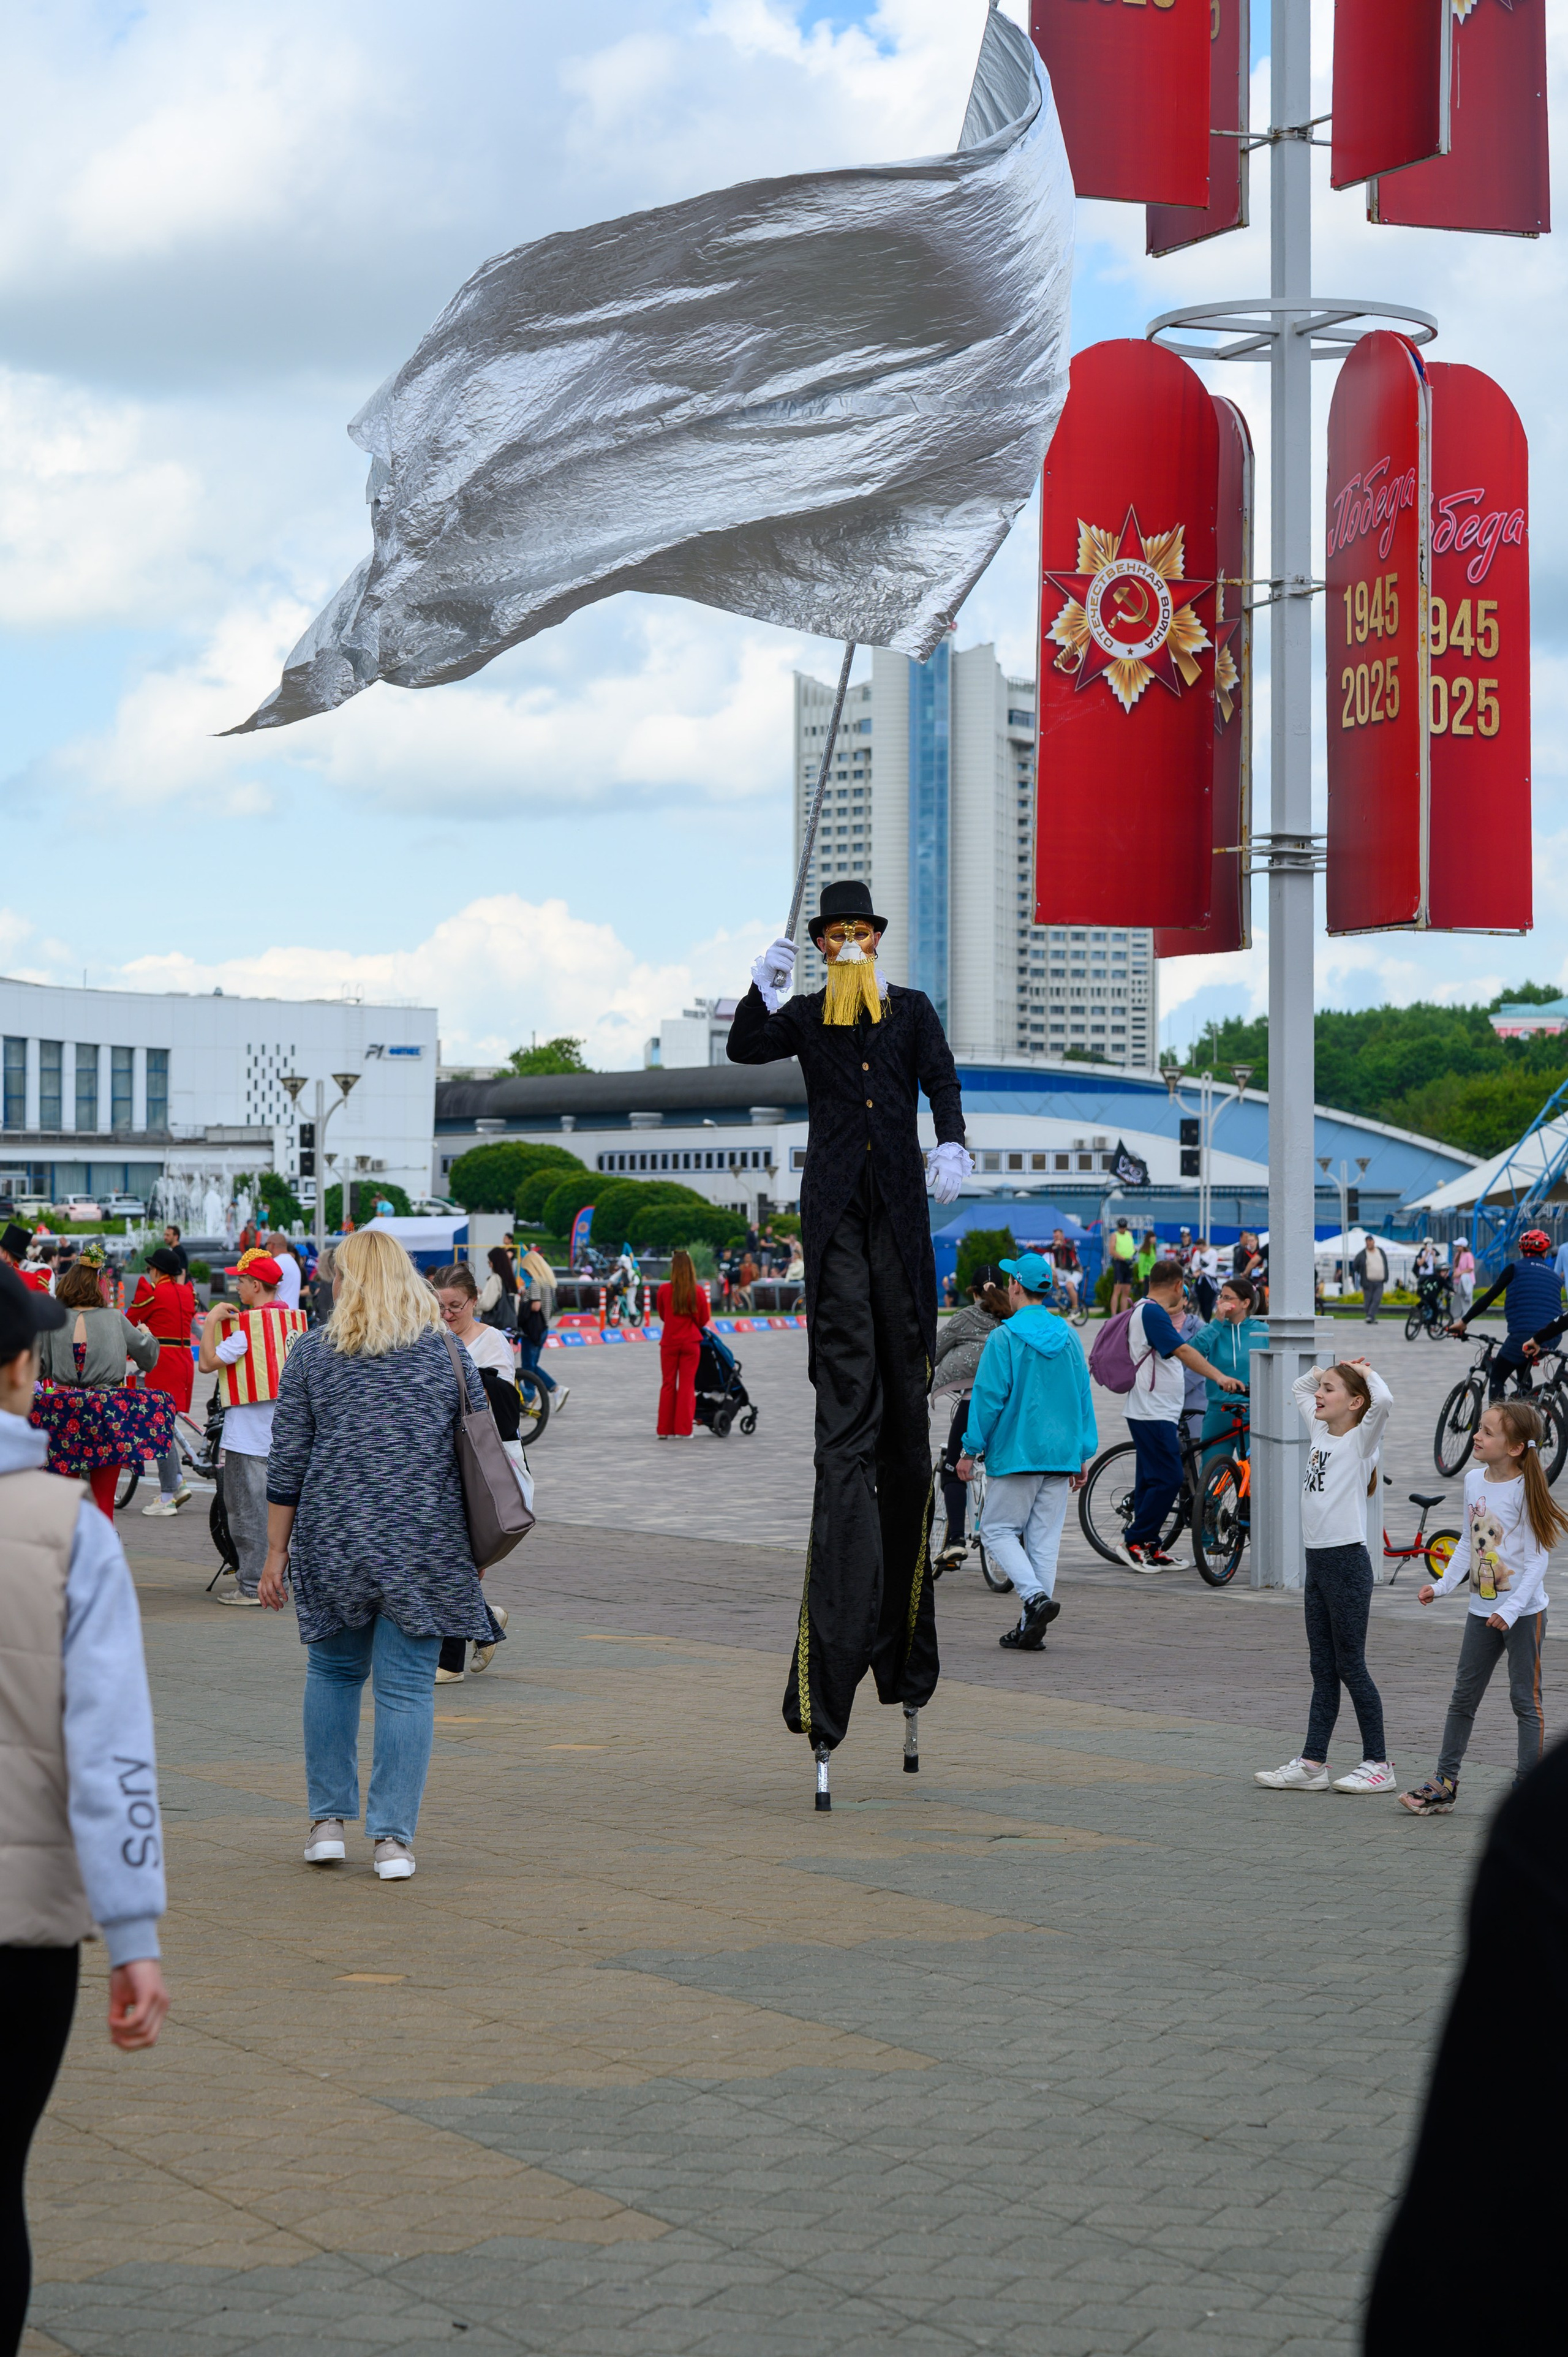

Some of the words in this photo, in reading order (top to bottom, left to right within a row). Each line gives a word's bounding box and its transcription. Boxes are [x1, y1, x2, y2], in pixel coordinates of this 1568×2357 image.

[1327, 456, 1415, 559] Победа
[1431, 488, 1525, 584] беда
[1090, 563, 1164, 649] ОТЕЧЕСТВЕННАЯ
[1343, 572, 1400, 646] 1945
[1431, 596, 1499, 658] 945
[1341, 656, 1400, 728] 2025
[1430, 675, 1500, 736] 025
